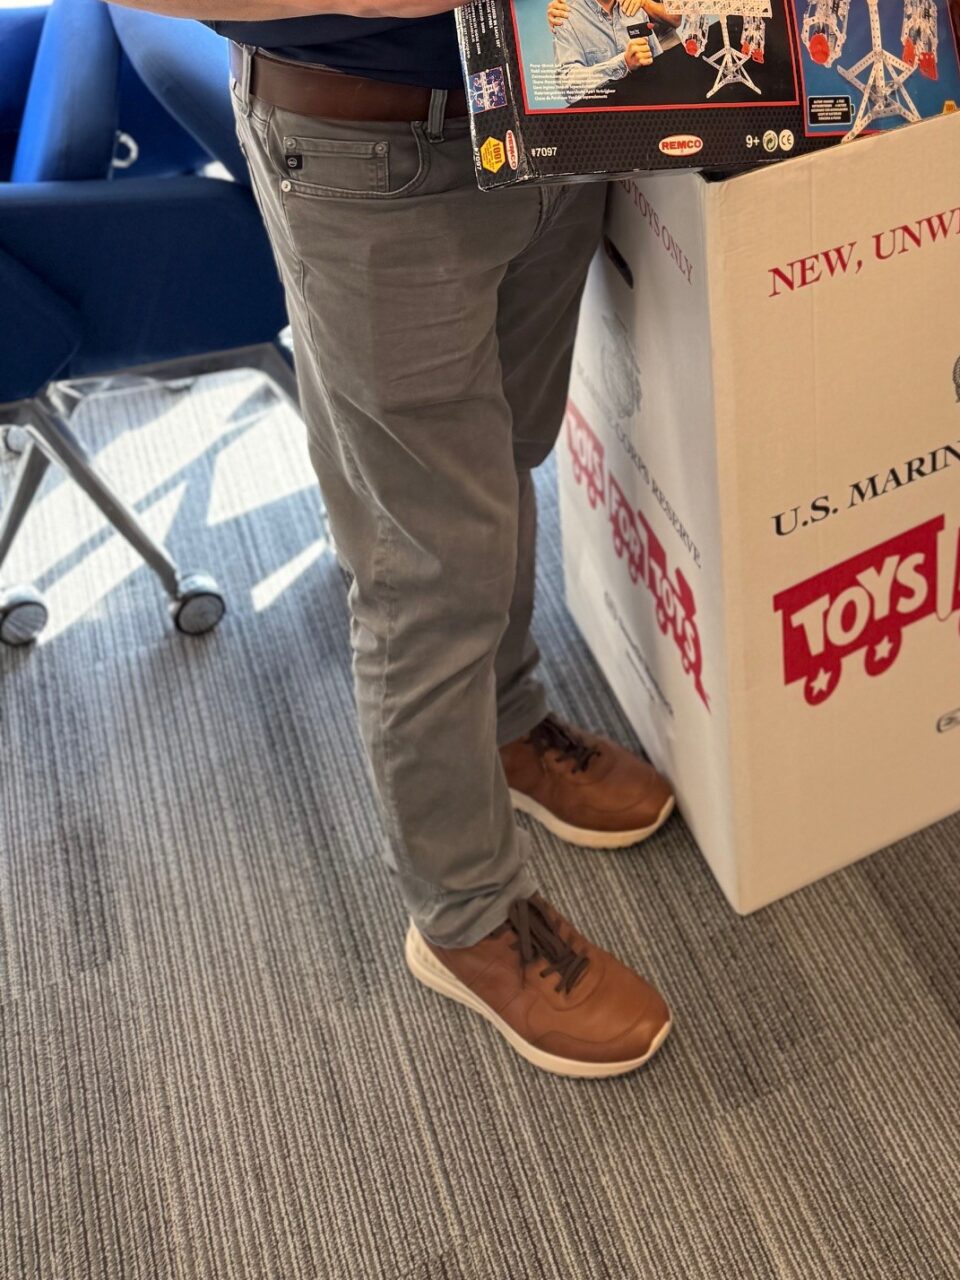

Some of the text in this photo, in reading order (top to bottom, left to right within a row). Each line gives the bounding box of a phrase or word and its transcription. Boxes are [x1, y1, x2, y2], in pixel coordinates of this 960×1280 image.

[531, 147, 557, 157] #7097
[661, 139, 701, 151] REMCO
[745, 135, 760, 148] 9+
[630, 181, 693, 286] TOYS ONLY
[768, 241, 863, 298] NEW,
[771, 496, 839, 537] U.S.
[610, 484, 642, 570] FOR
[649, 558, 697, 665] TOTS
[790, 551, 929, 657] TOYS
